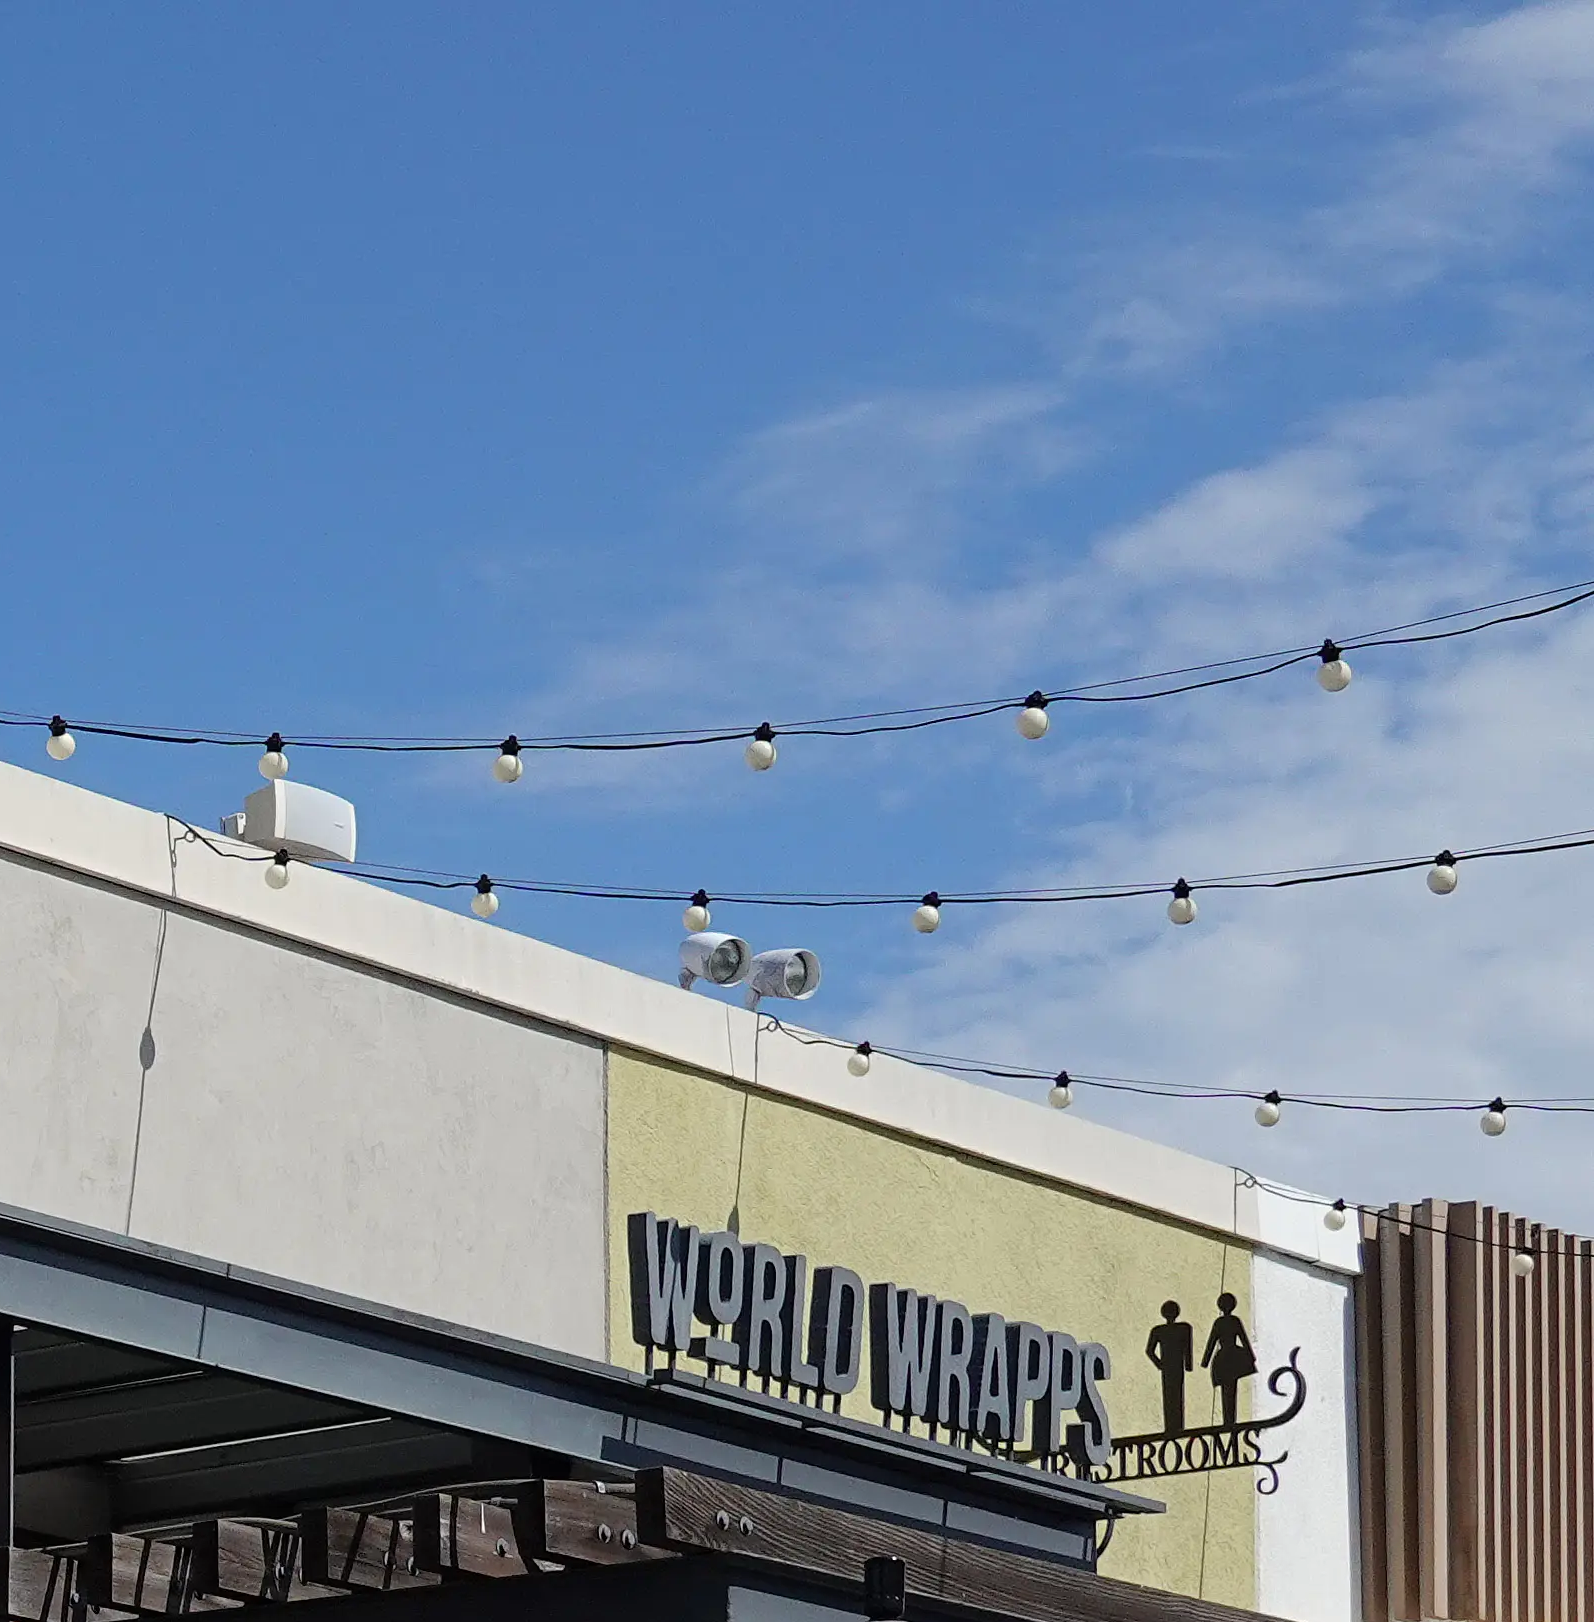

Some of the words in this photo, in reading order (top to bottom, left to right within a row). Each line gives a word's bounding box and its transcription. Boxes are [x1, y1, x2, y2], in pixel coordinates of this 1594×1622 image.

[631, 1211, 864, 1396] WORLD
[870, 1281, 1112, 1466] WRAPPS
[1047, 1428, 1261, 1482] RSTROOMS
